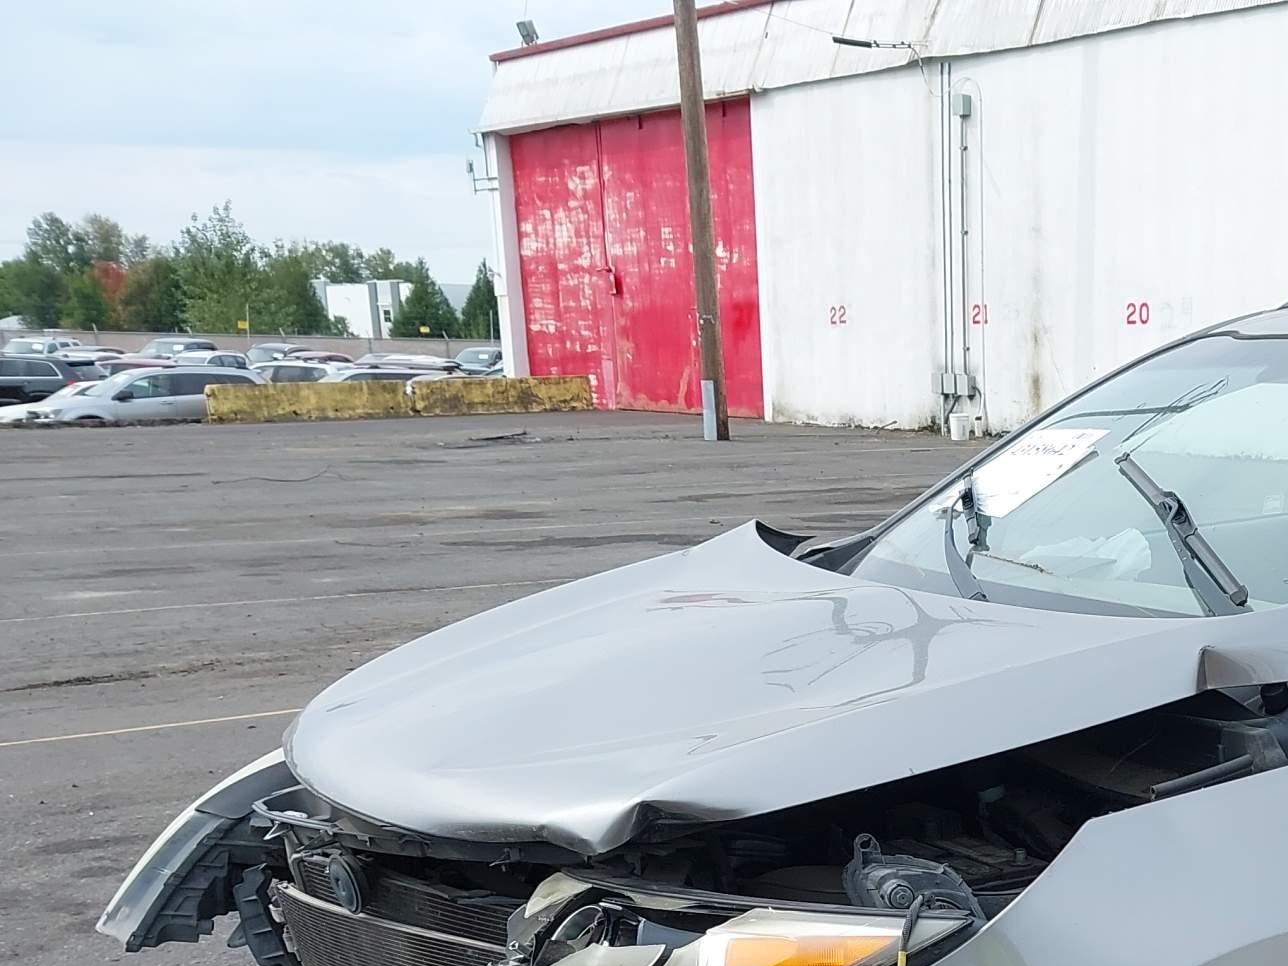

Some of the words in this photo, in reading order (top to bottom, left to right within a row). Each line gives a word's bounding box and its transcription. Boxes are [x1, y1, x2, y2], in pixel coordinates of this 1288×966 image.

[829, 305, 847, 324] 22
[972, 304, 988, 324] 21
[1126, 302, 1149, 324] 20
